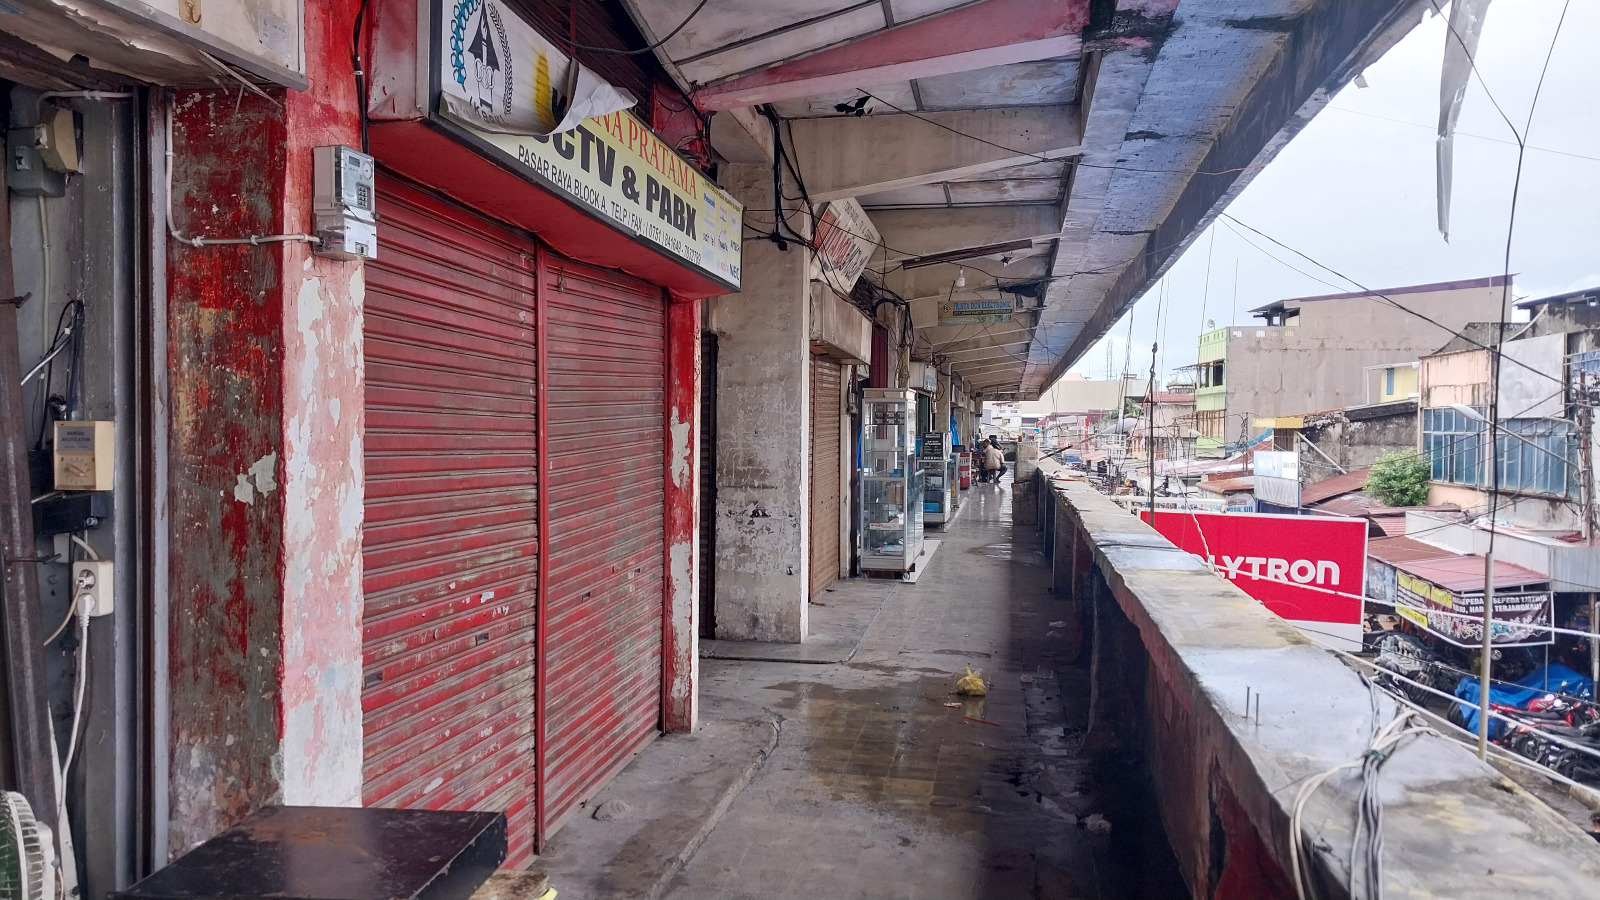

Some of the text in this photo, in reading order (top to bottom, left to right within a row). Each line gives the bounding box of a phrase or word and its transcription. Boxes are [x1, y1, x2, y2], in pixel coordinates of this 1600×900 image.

[518, 144, 550, 180] PASAR
[551, 164, 572, 193] RAYA
[575, 178, 600, 209] BLOCK
[533, 122, 616, 188] CTV
[621, 165, 640, 206] &
[646, 173, 697, 242] PABX
[628, 117, 698, 200] PRATAMA
[729, 263, 740, 280] NEC
[981, 300, 1012, 310] ELECTRONIC
[1196, 554, 1341, 586] LYTRON
